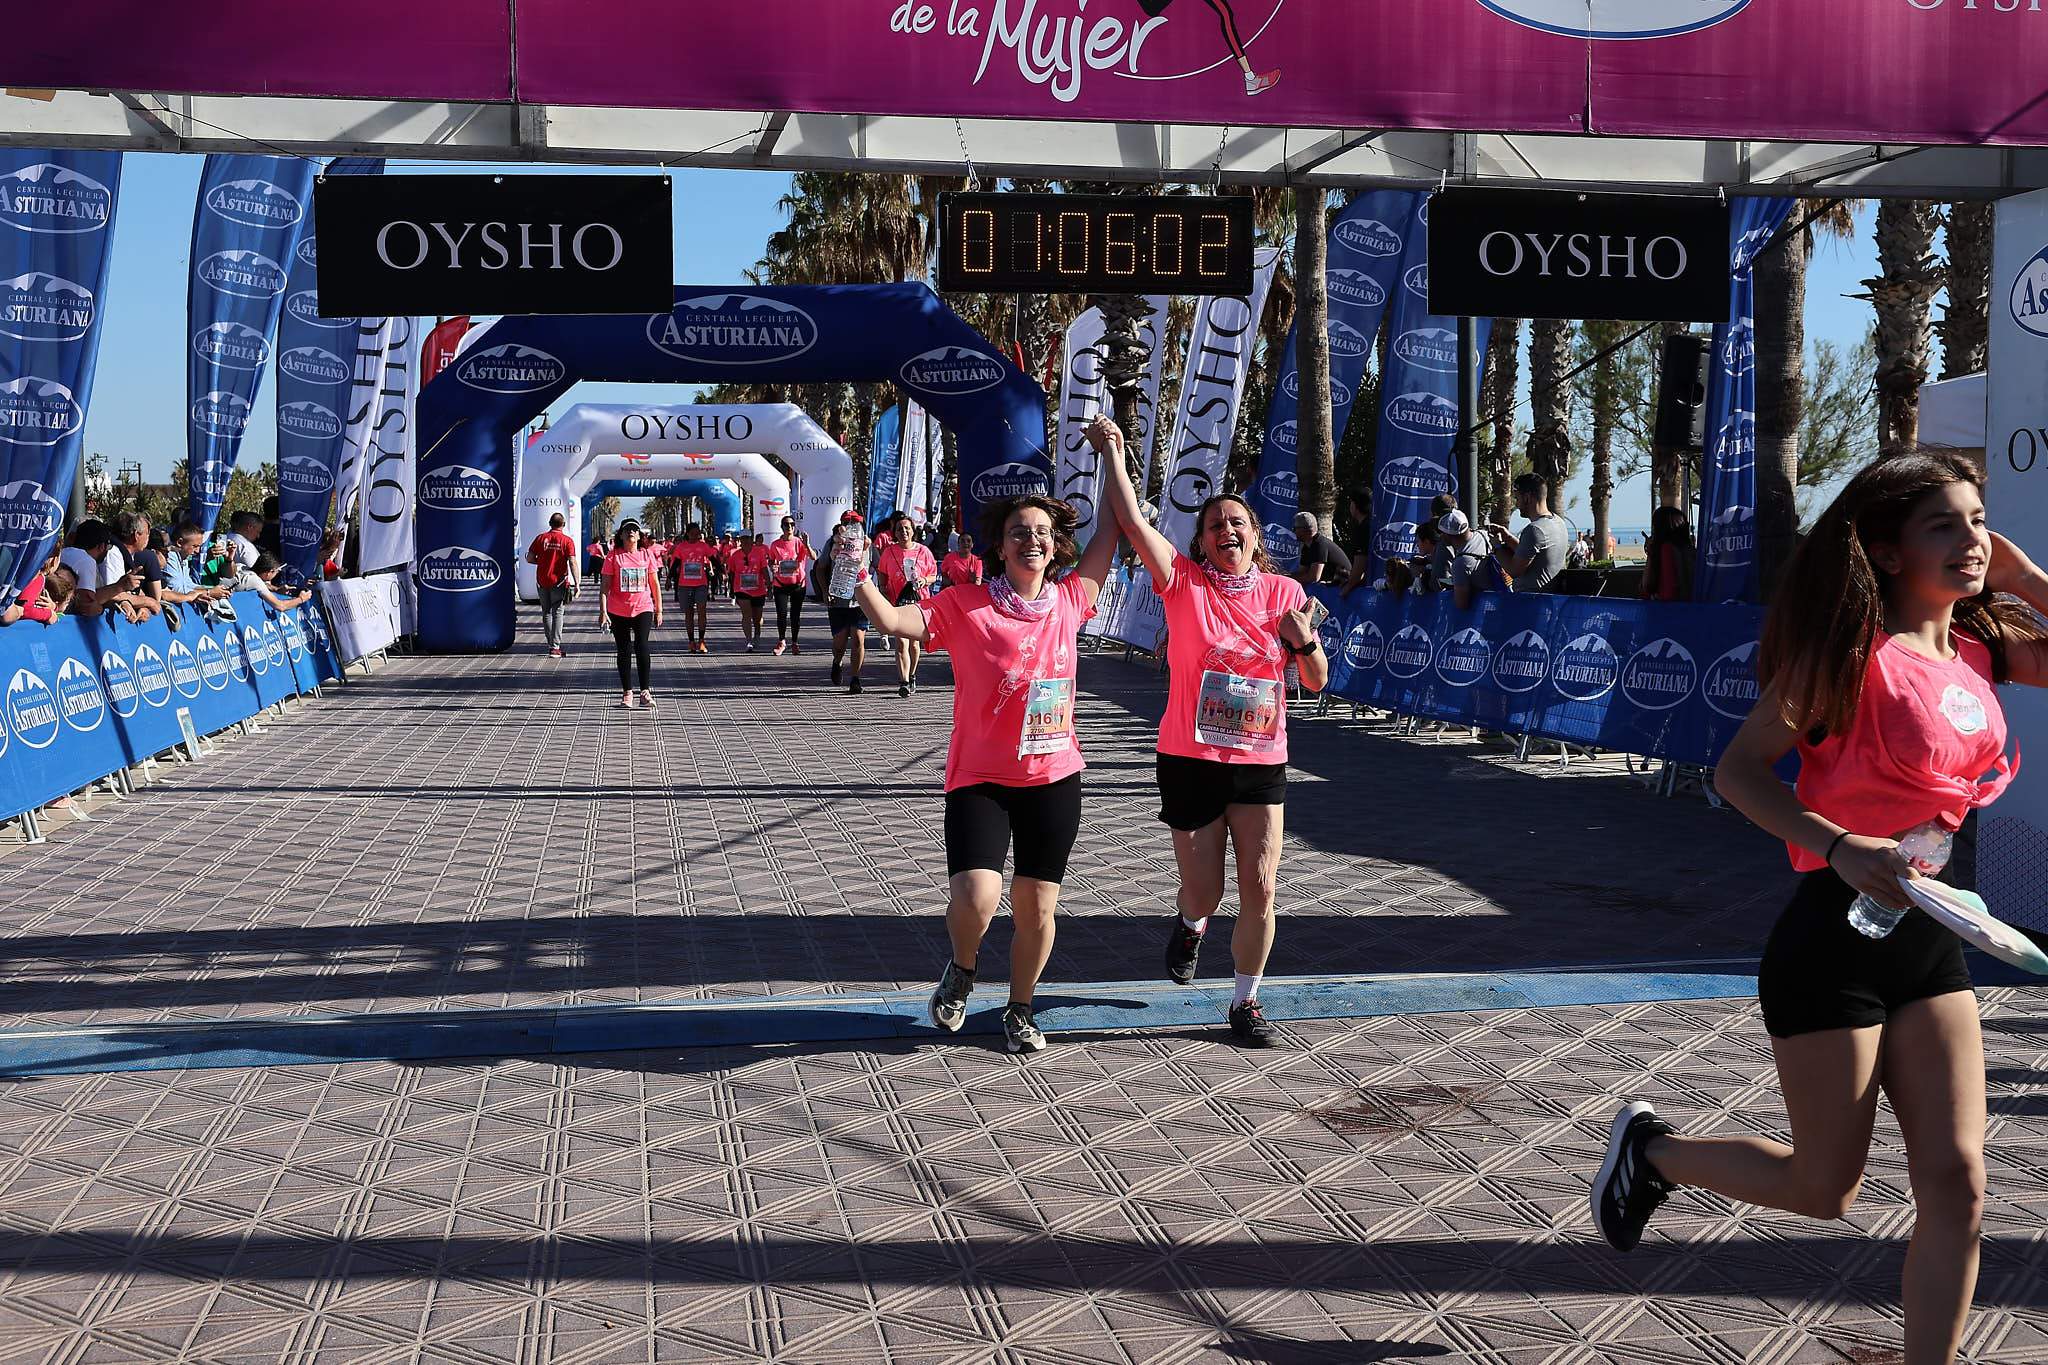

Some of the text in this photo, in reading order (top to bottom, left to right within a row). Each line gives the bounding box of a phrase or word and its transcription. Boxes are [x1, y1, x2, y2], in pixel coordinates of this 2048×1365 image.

[973, 0, 1168, 102] Mujer
[213, 191, 294, 220] ASTURIANA
[376, 221, 623, 271] OYSHO
[963, 210, 1228, 276] 01:06:02
[1338, 225, 1396, 252] ASTURIANA
[1479, 231, 1687, 280] OYSHO
[1327, 281, 1379, 303] STURIANA
[660, 314, 805, 347] ASTURIANA
[686, 314, 799, 323] CENTRAL LECHERA
[1400, 339, 1457, 364] ASTURIA
[284, 355, 344, 379] ASTURIANA
[462, 358, 557, 382] ASTURIANA
[909, 366, 999, 384] ASTURIANA
[1170, 295, 1251, 513] OYSHO
[280, 410, 337, 433] ASTURIANA
[621, 414, 753, 441] OYSHO
[541, 444, 582, 454] OYSHO
[790, 442, 829, 452] OYSHO
[422, 482, 496, 500] ASTURIANA
[811, 496, 847, 505] OYSHO
[976, 480, 1047, 497] ASTURIANA
[524, 498, 562, 508] OYSHO
[422, 562, 496, 580] ASTURIANA
[1387, 641, 1427, 666] ASTURIANA
[1438, 647, 1485, 672] ASTURIANA
[1494, 652, 1544, 677] ASTURIANA
[1554, 655, 1612, 685] ASTURIANA
[1625, 662, 1689, 693] ASTURIANA
[61, 689, 103, 717] ASTURIANA
[12, 701, 57, 732] ASTURIANA
